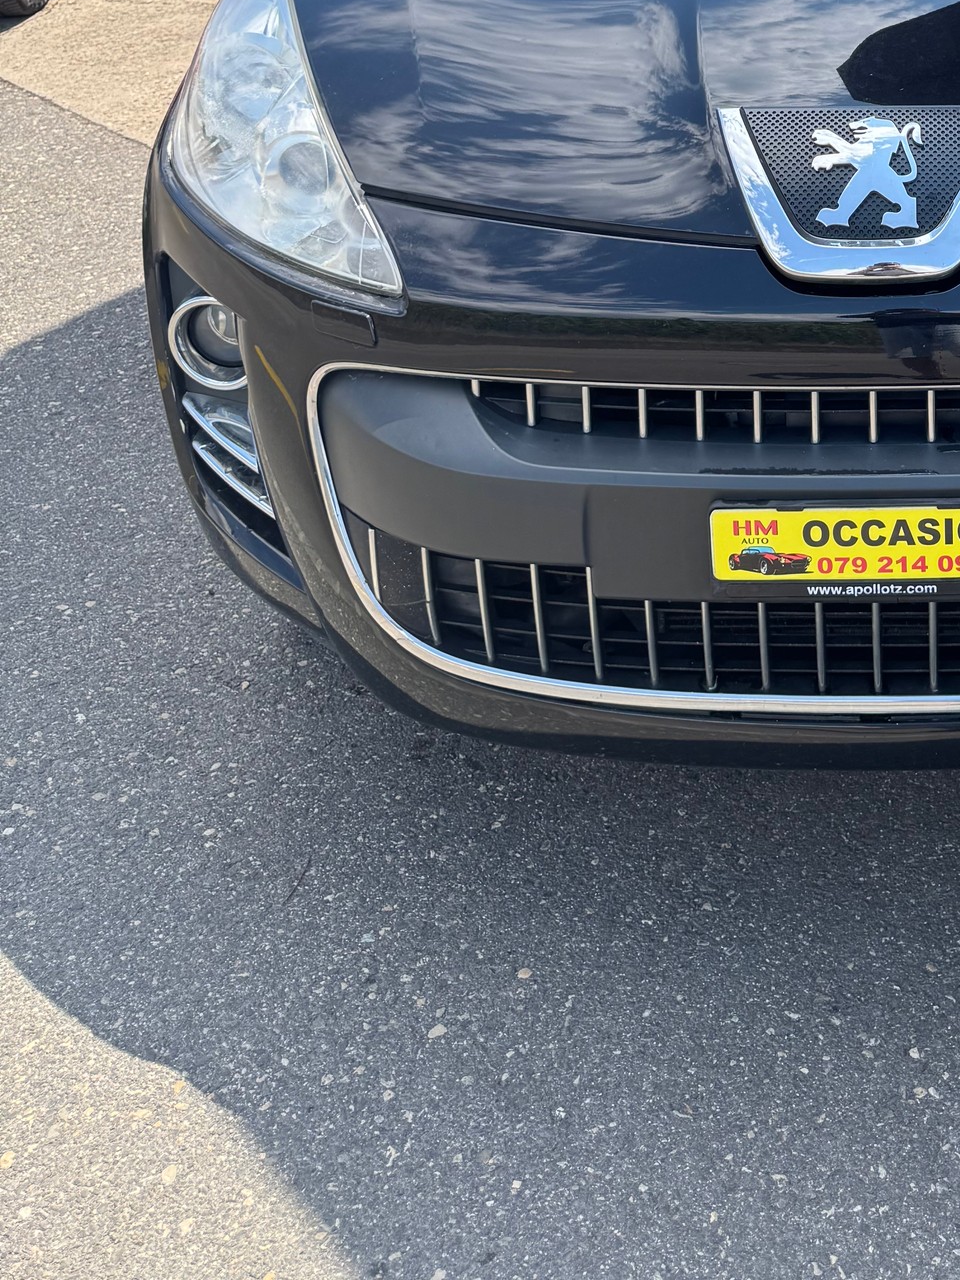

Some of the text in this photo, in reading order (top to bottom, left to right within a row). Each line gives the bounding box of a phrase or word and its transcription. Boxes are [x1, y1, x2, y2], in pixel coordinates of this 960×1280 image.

[732, 520, 779, 536] HM
[741, 537, 769, 545] AUTO
[817, 556, 868, 574] 079
[877, 556, 929, 573] 214
[807, 583, 938, 597] www.apollotz.com
